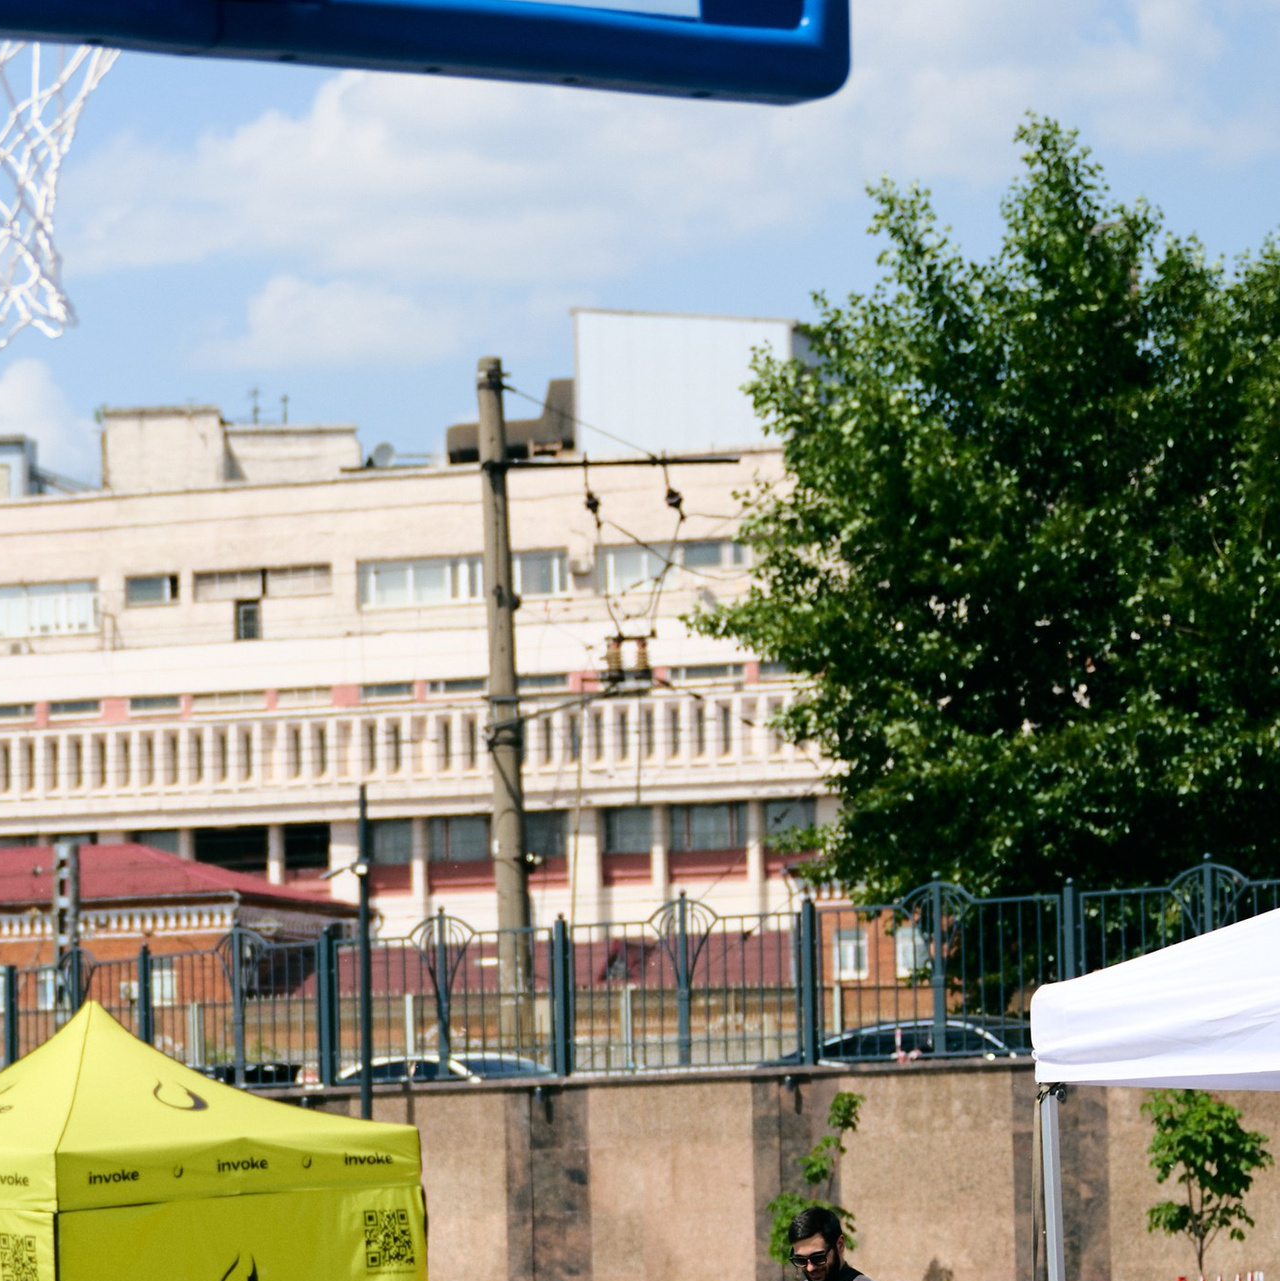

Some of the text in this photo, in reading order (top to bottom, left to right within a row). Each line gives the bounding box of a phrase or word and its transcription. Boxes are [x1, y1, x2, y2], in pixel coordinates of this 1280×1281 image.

[88, 1152, 393, 1185] invoke invoke invoke
